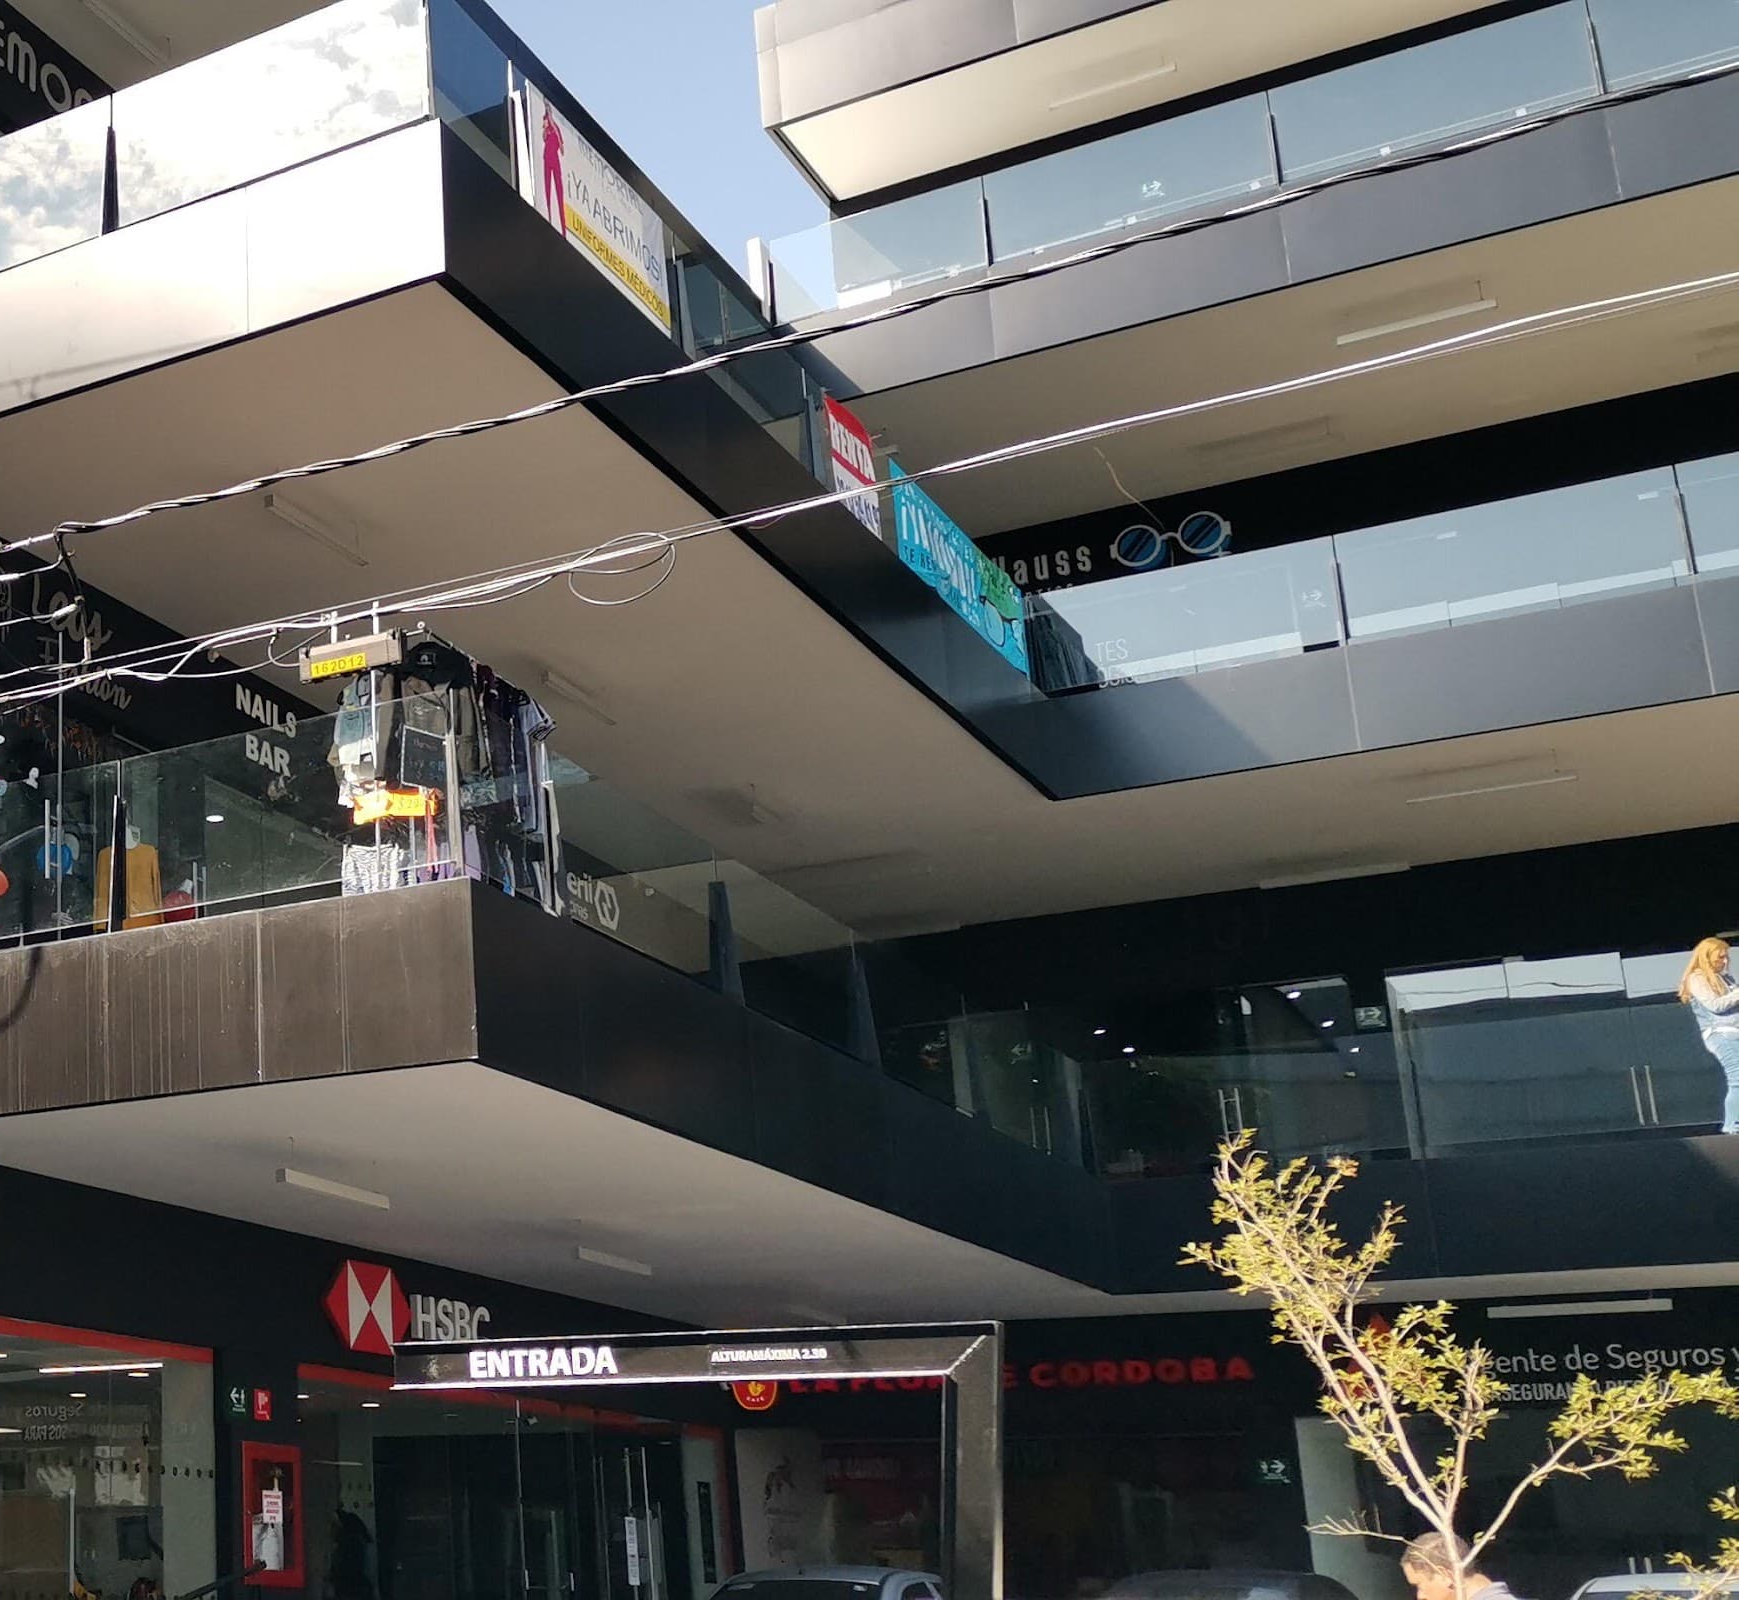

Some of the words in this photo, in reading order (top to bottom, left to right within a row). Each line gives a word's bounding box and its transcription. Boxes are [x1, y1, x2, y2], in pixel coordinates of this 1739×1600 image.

[993, 545, 1092, 586] auss
[314, 654, 364, 676] 162D12
[235, 682, 297, 738] NAILS
[245, 734, 292, 778] BAR
[409, 1294, 491, 1342] HSBC
[468, 1346, 619, 1379] ENTRADA
[1029, 1356, 1255, 1388] CORDOBA
[1482, 1347, 1558, 1380] gente
[1564, 1343, 1600, 1371] de
[1605, 1343, 1726, 1375] Seguros
